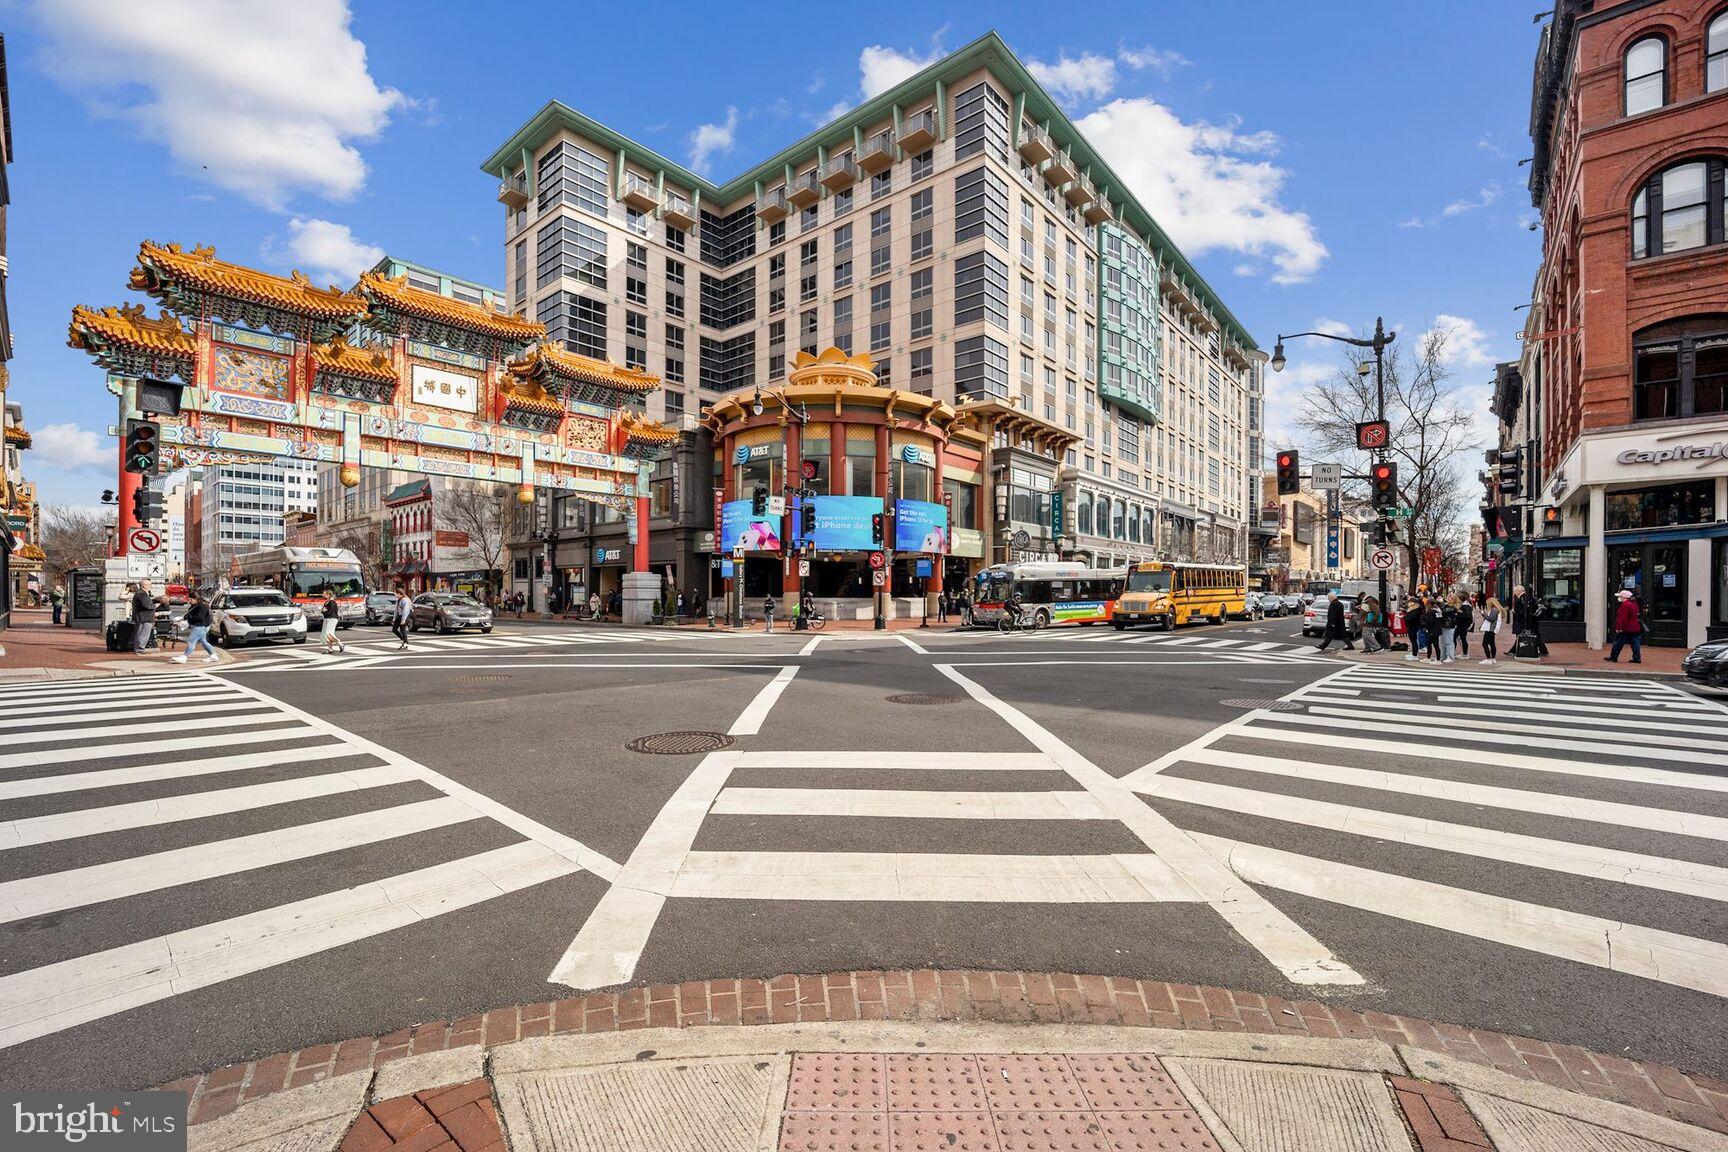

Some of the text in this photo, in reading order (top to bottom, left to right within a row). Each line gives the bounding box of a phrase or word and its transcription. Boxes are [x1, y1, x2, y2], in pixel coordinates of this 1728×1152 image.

[750, 445, 770, 457] AT&T
[900, 508, 911, 516] Get
[822, 521, 853, 529] iPhone
[605, 549, 621, 560] AT&T
[733, 548, 743, 558] M
[1019, 551, 1046, 563] CIRCA
[711, 559, 721, 569] &T
